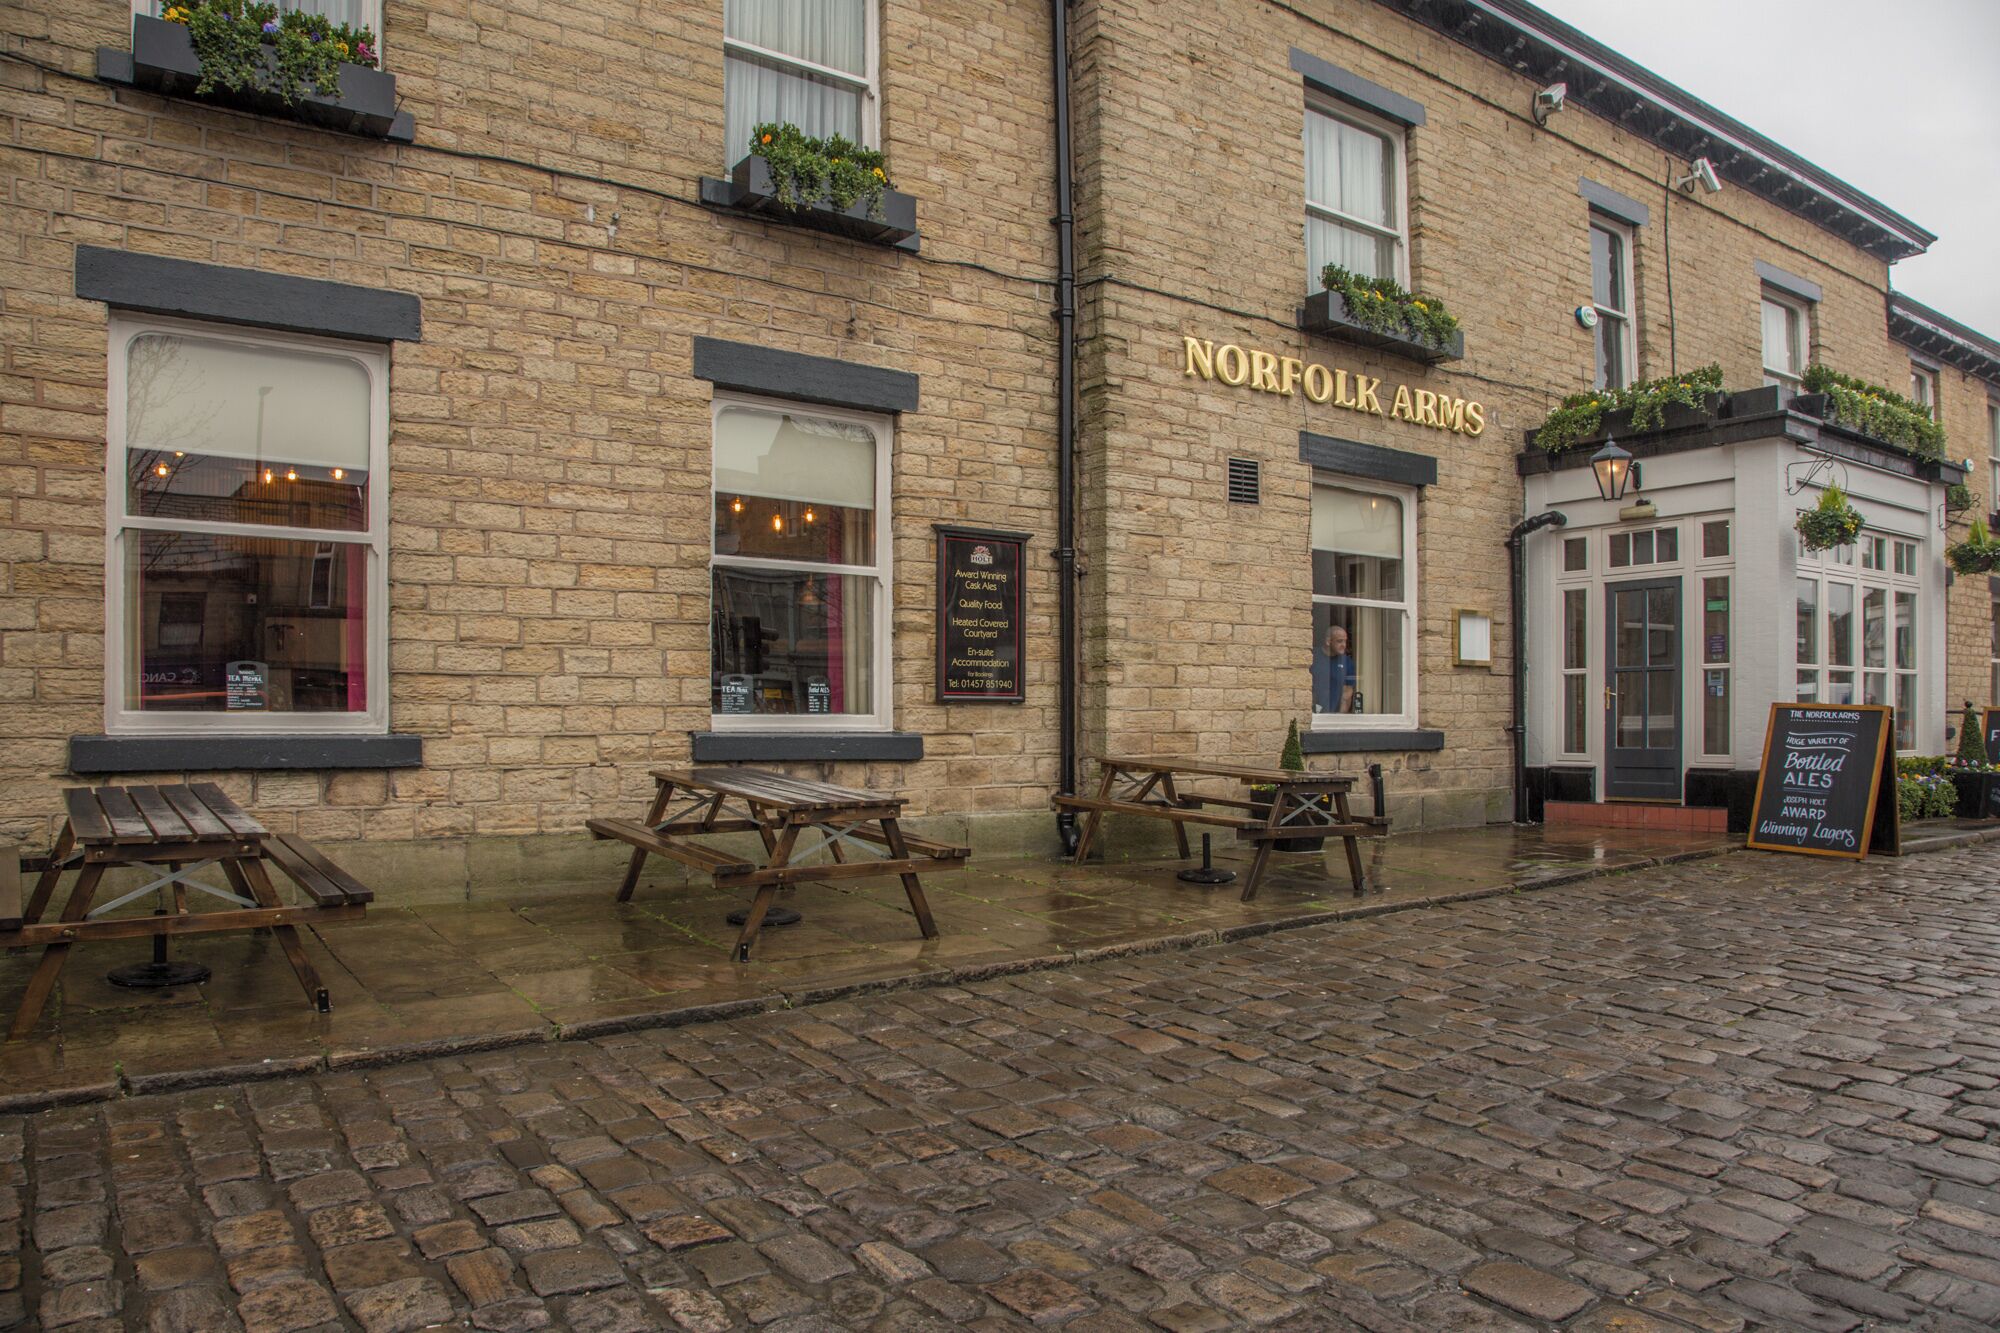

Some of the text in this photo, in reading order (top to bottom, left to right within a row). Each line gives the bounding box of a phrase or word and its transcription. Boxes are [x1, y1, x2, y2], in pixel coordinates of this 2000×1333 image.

[1184, 336, 1485, 437] NORFOLK ARMS
[955, 569, 1007, 582] Award Winning
[965, 581, 997, 591] Cask Ales
[959, 598, 1002, 610] Quality Food
[952, 617, 1009, 628] Heated Covered
[963, 628, 998, 639] Courtyard
[967, 647, 994, 656] En-suite
[951, 658, 1009, 668] Accommodation
[948, 679, 1013, 689] Tel: 01457 851940
[1790, 710, 1860, 720] THE NORFOLK ARMS
[1786, 736, 1806, 745] HUGE
[1807, 737, 1838, 745] VARIETY
[1784, 752, 1846, 771] Bottled
[1783, 772, 1833, 788] ALES
[1783, 796, 1827, 806] JOSEPH HOLT
[1780, 806, 1827, 820] AWARD
[1760, 820, 1855, 848] Winning Lagers
